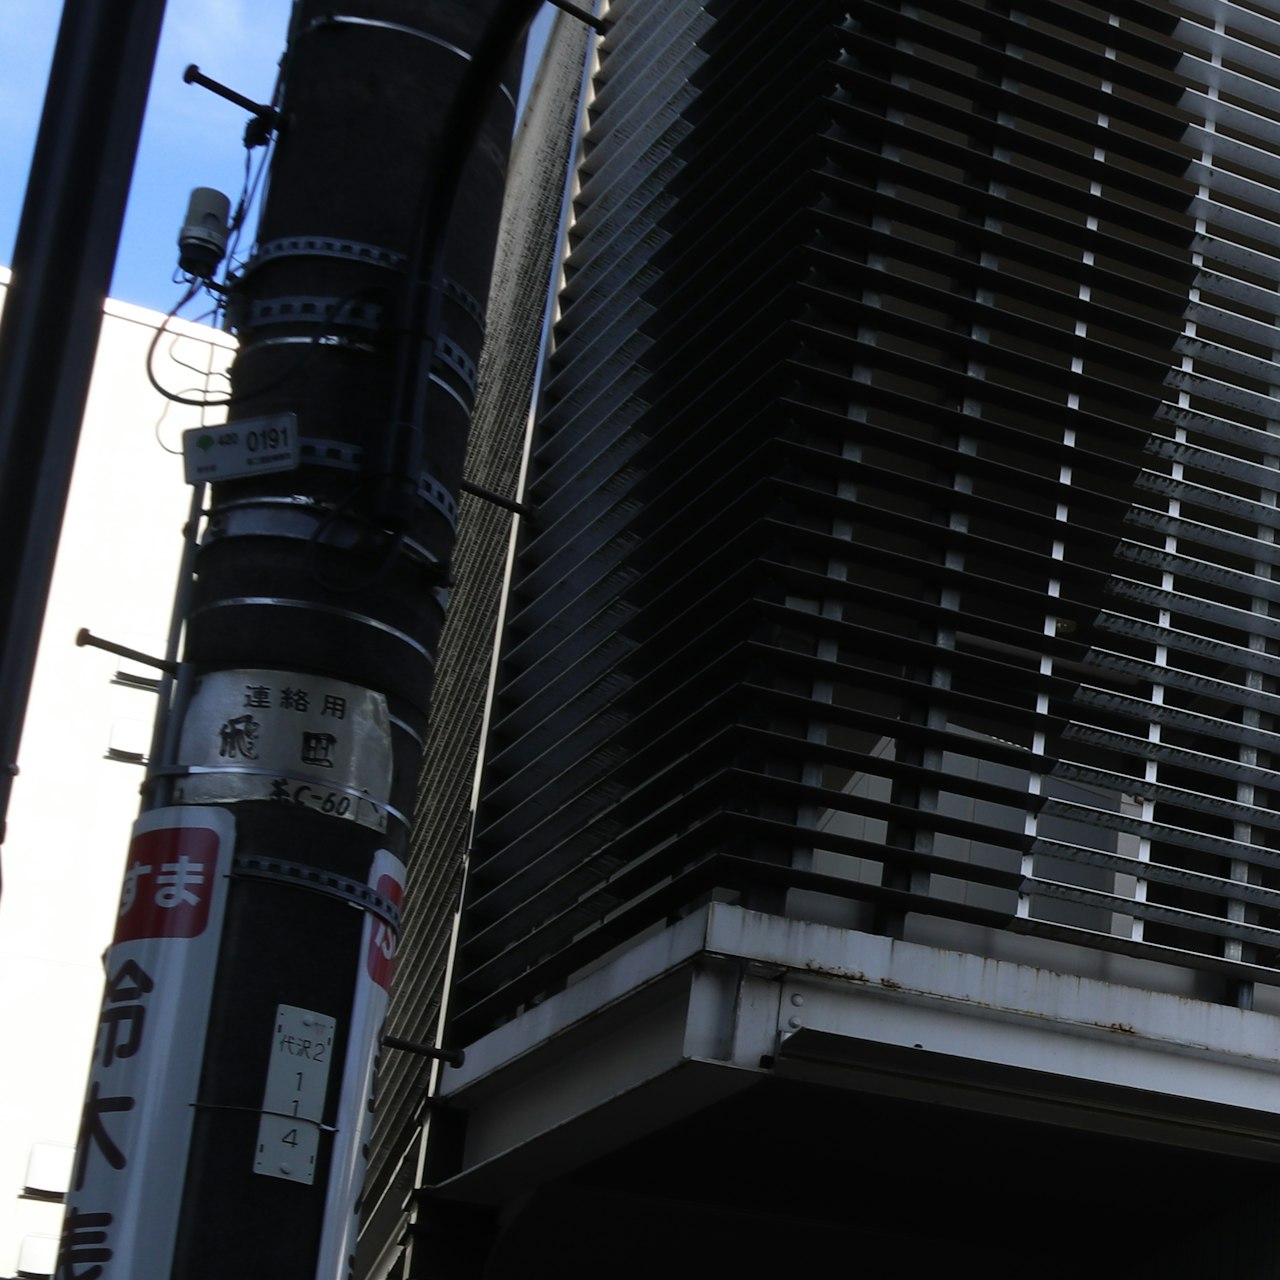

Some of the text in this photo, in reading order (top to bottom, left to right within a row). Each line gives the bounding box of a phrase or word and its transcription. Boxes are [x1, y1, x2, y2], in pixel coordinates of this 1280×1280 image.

[246, 426, 289, 453] 0191
[244, 685, 347, 720] 連絡用
[280, 1033, 326, 1063] 代沢2
[281, 1128, 299, 1148] 4
